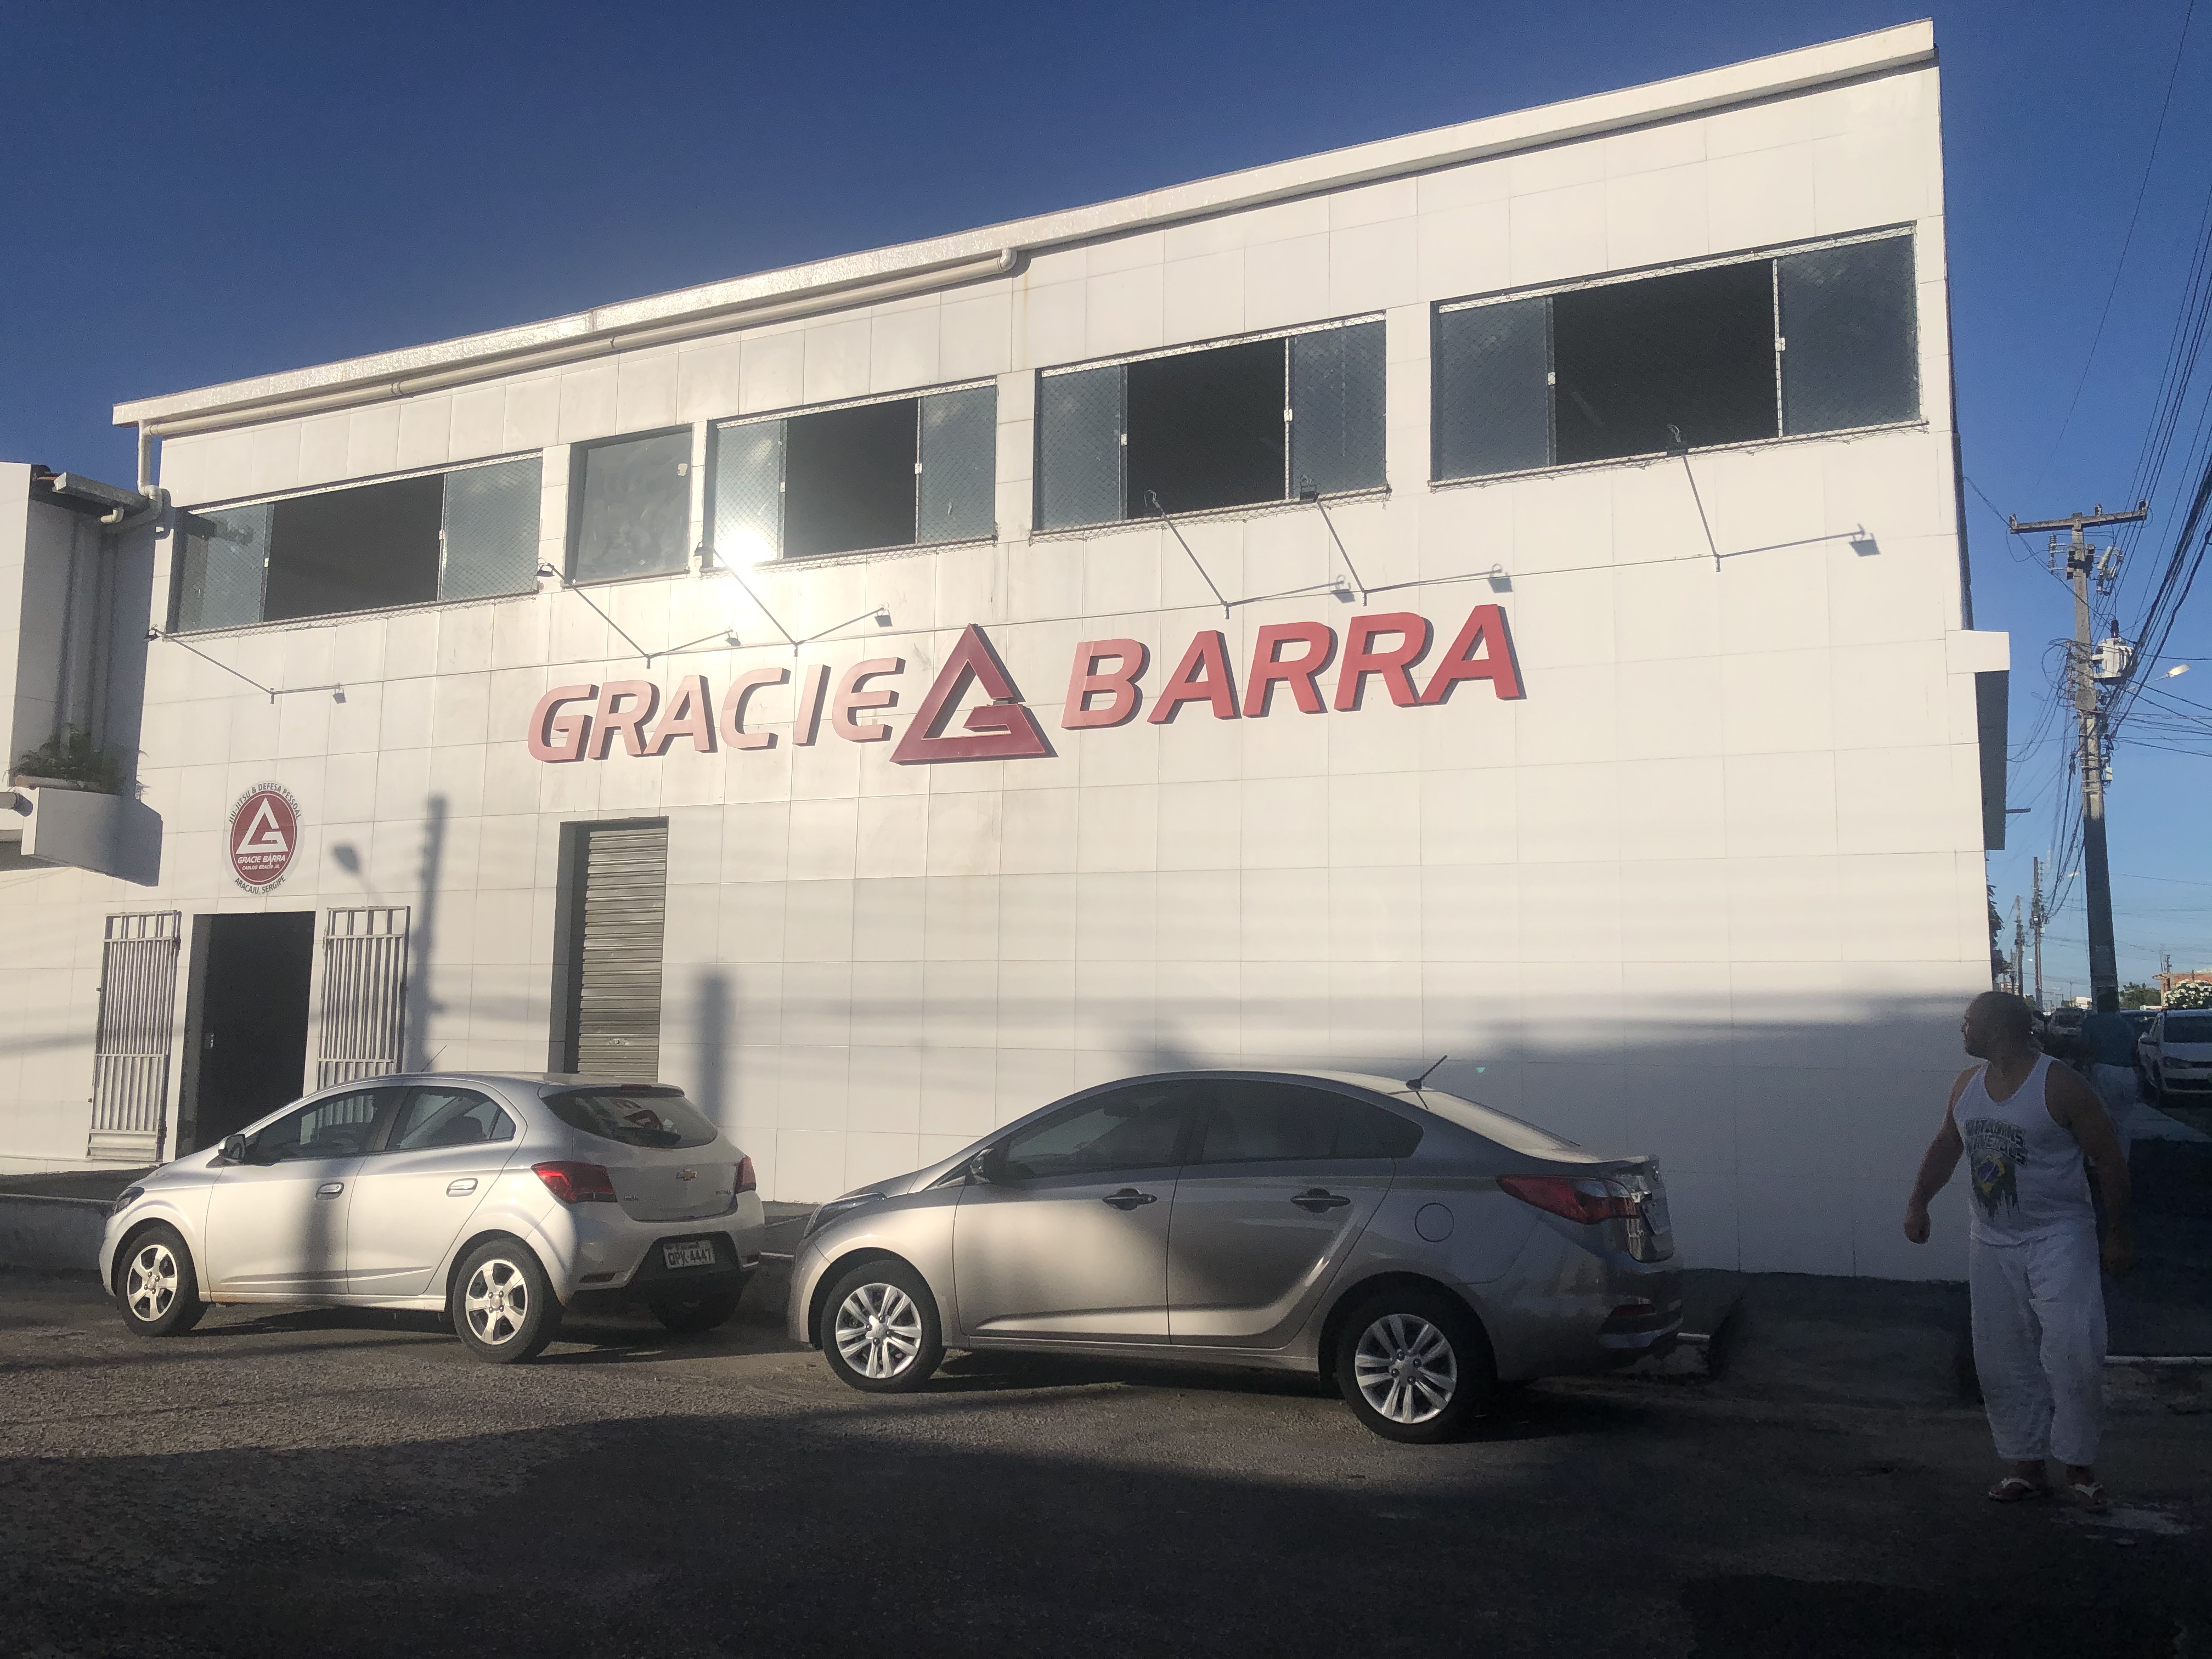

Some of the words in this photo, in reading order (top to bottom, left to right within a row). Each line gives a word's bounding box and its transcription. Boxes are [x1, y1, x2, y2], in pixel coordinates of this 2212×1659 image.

[528, 657, 906, 763] GRACIE
[1060, 603, 1527, 731] BARRA
[228, 790, 251, 825] JIU-JITSU
[258, 782, 282, 793] DEFESA
[281, 788, 302, 821] PESSOAL
[238, 855, 262, 864] GRACIE
[262, 854, 286, 863] BARRA
[234, 877, 261, 895] ARACAJU,
[262, 874, 286, 894] SERGIPE
